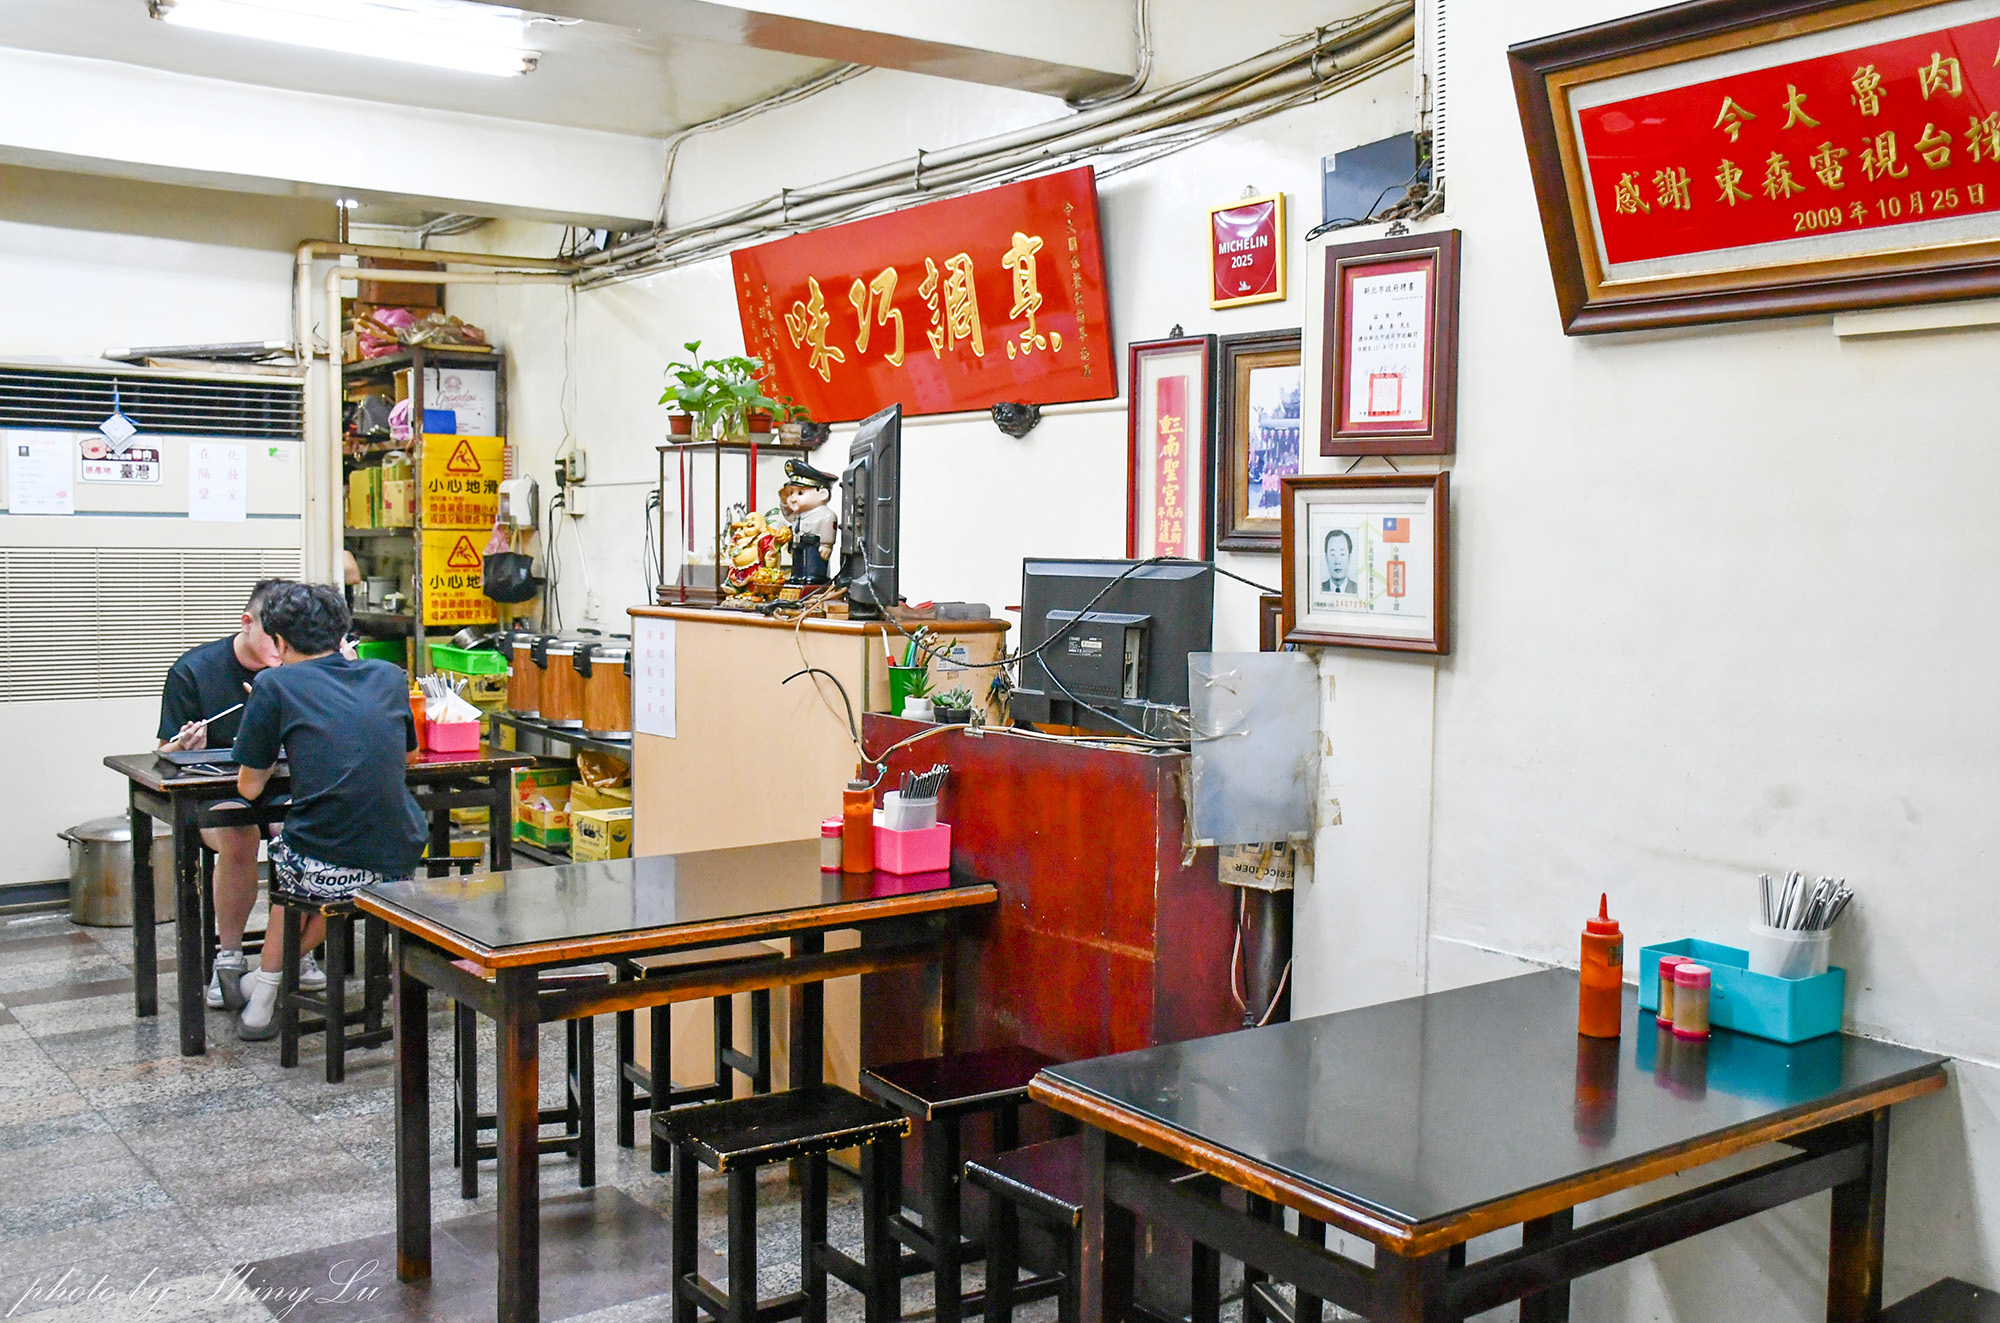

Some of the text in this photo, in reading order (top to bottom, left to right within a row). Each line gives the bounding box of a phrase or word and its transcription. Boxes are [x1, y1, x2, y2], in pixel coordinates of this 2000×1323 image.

[1713, 38, 2000, 143] 今大魯肉
[1218, 235, 1268, 255] MICHELIN
[1231, 254, 1254, 269] 2025
[120, 463, 150, 480] 臺灣
[197, 447, 212, 500] 在隔壁
[227, 449, 240, 501] 化妝室
[428, 477, 499, 495] 小心地滑
[430, 574, 481, 590] 小心地
[315, 872, 366, 886] BOOM!
